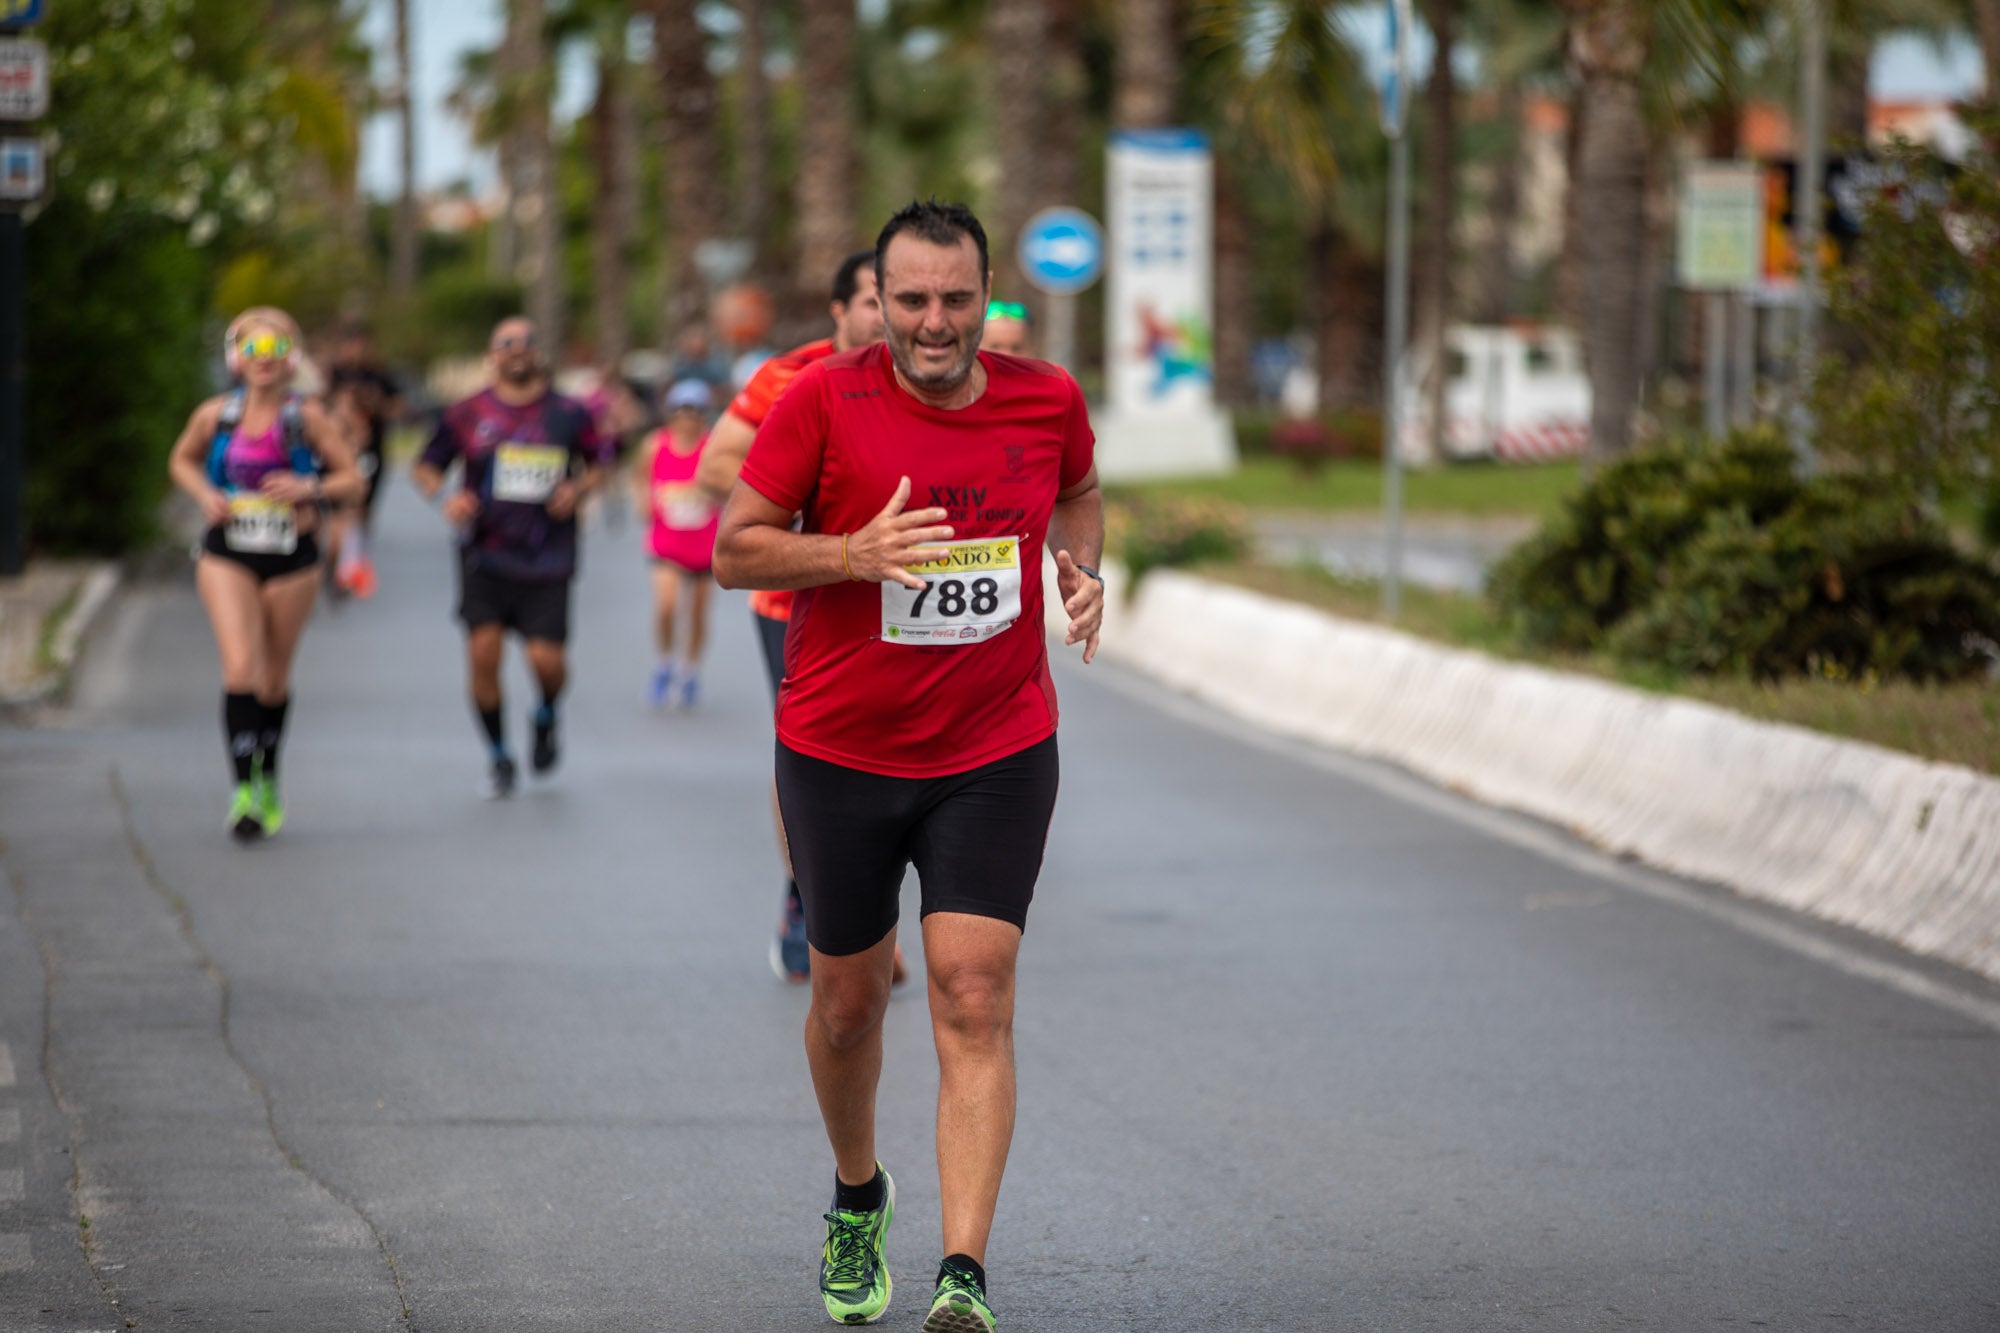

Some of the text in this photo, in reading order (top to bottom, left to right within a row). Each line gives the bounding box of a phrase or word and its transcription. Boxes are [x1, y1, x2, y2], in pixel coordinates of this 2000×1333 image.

[929, 486, 987, 507] XXIV
[950, 508, 1025, 521] DE FONDO
[954, 545, 985, 553] PREMIO
[904, 577, 998, 618] 788
